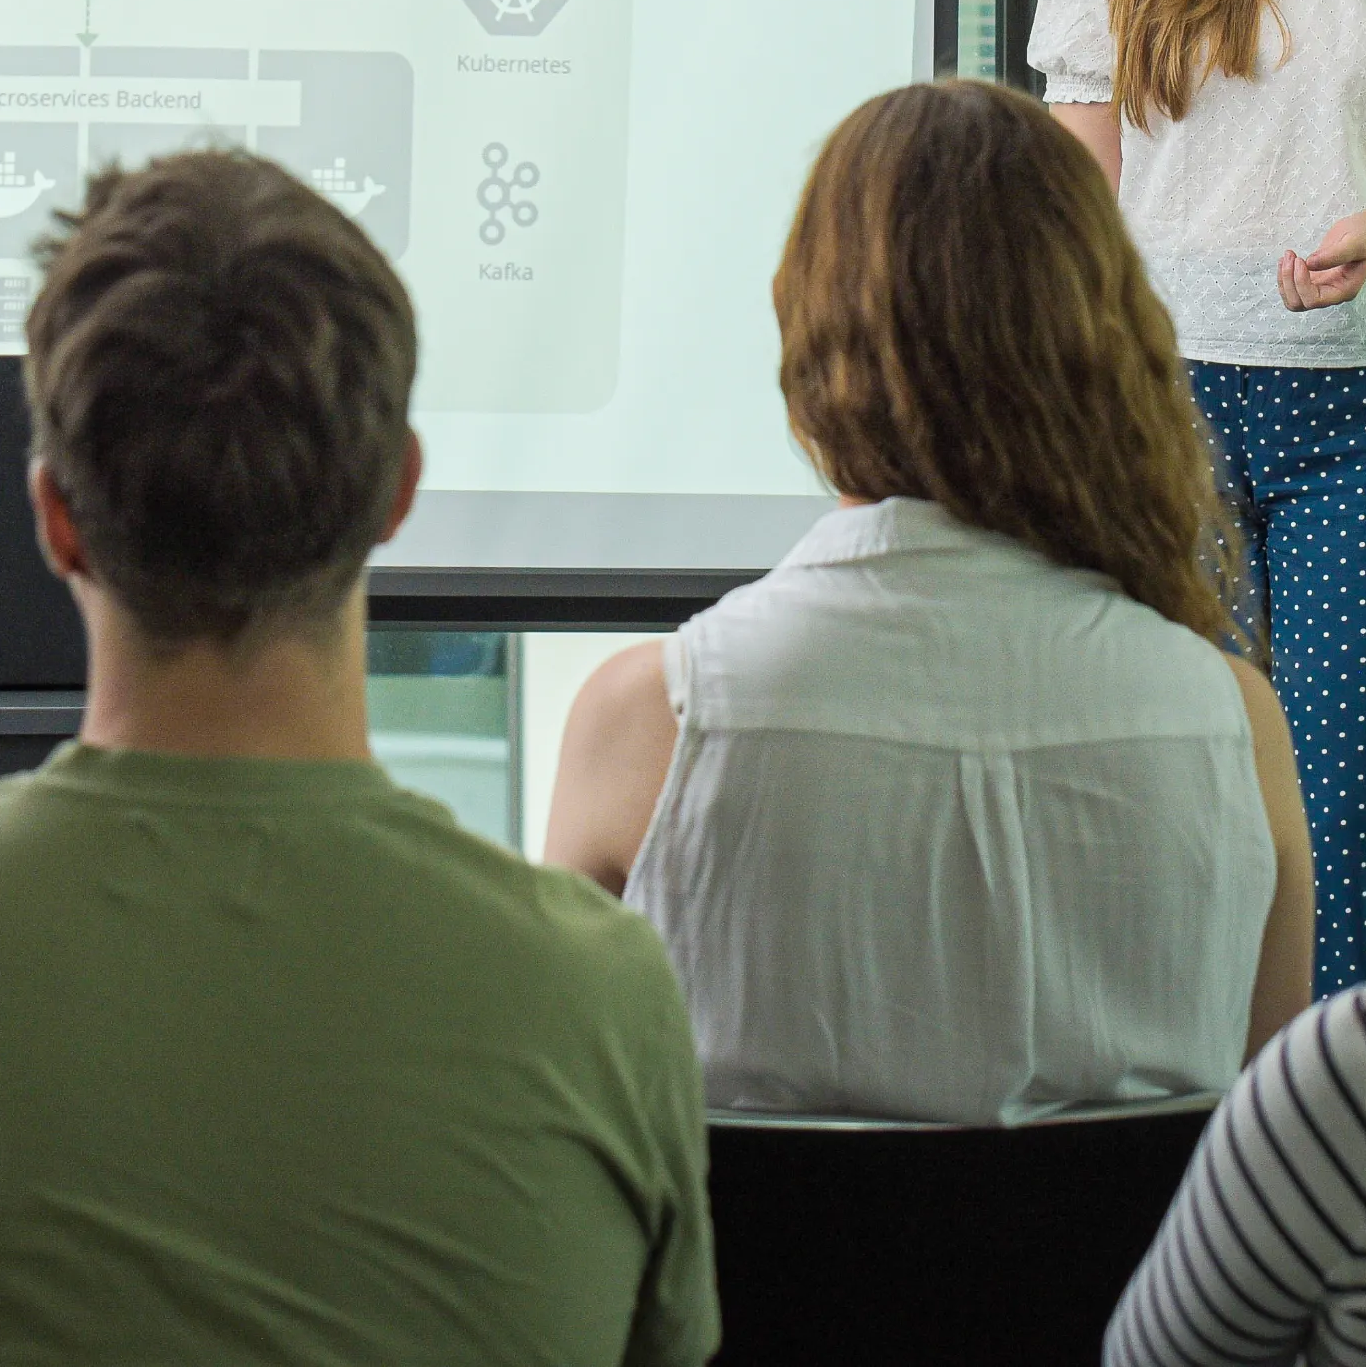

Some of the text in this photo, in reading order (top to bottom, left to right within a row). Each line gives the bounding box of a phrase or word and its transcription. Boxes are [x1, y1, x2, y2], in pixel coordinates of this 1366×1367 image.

[458, 54, 571, 74] Kubernetes
[117, 90, 201, 110] Backend
[480, 262, 533, 281] Kafka
